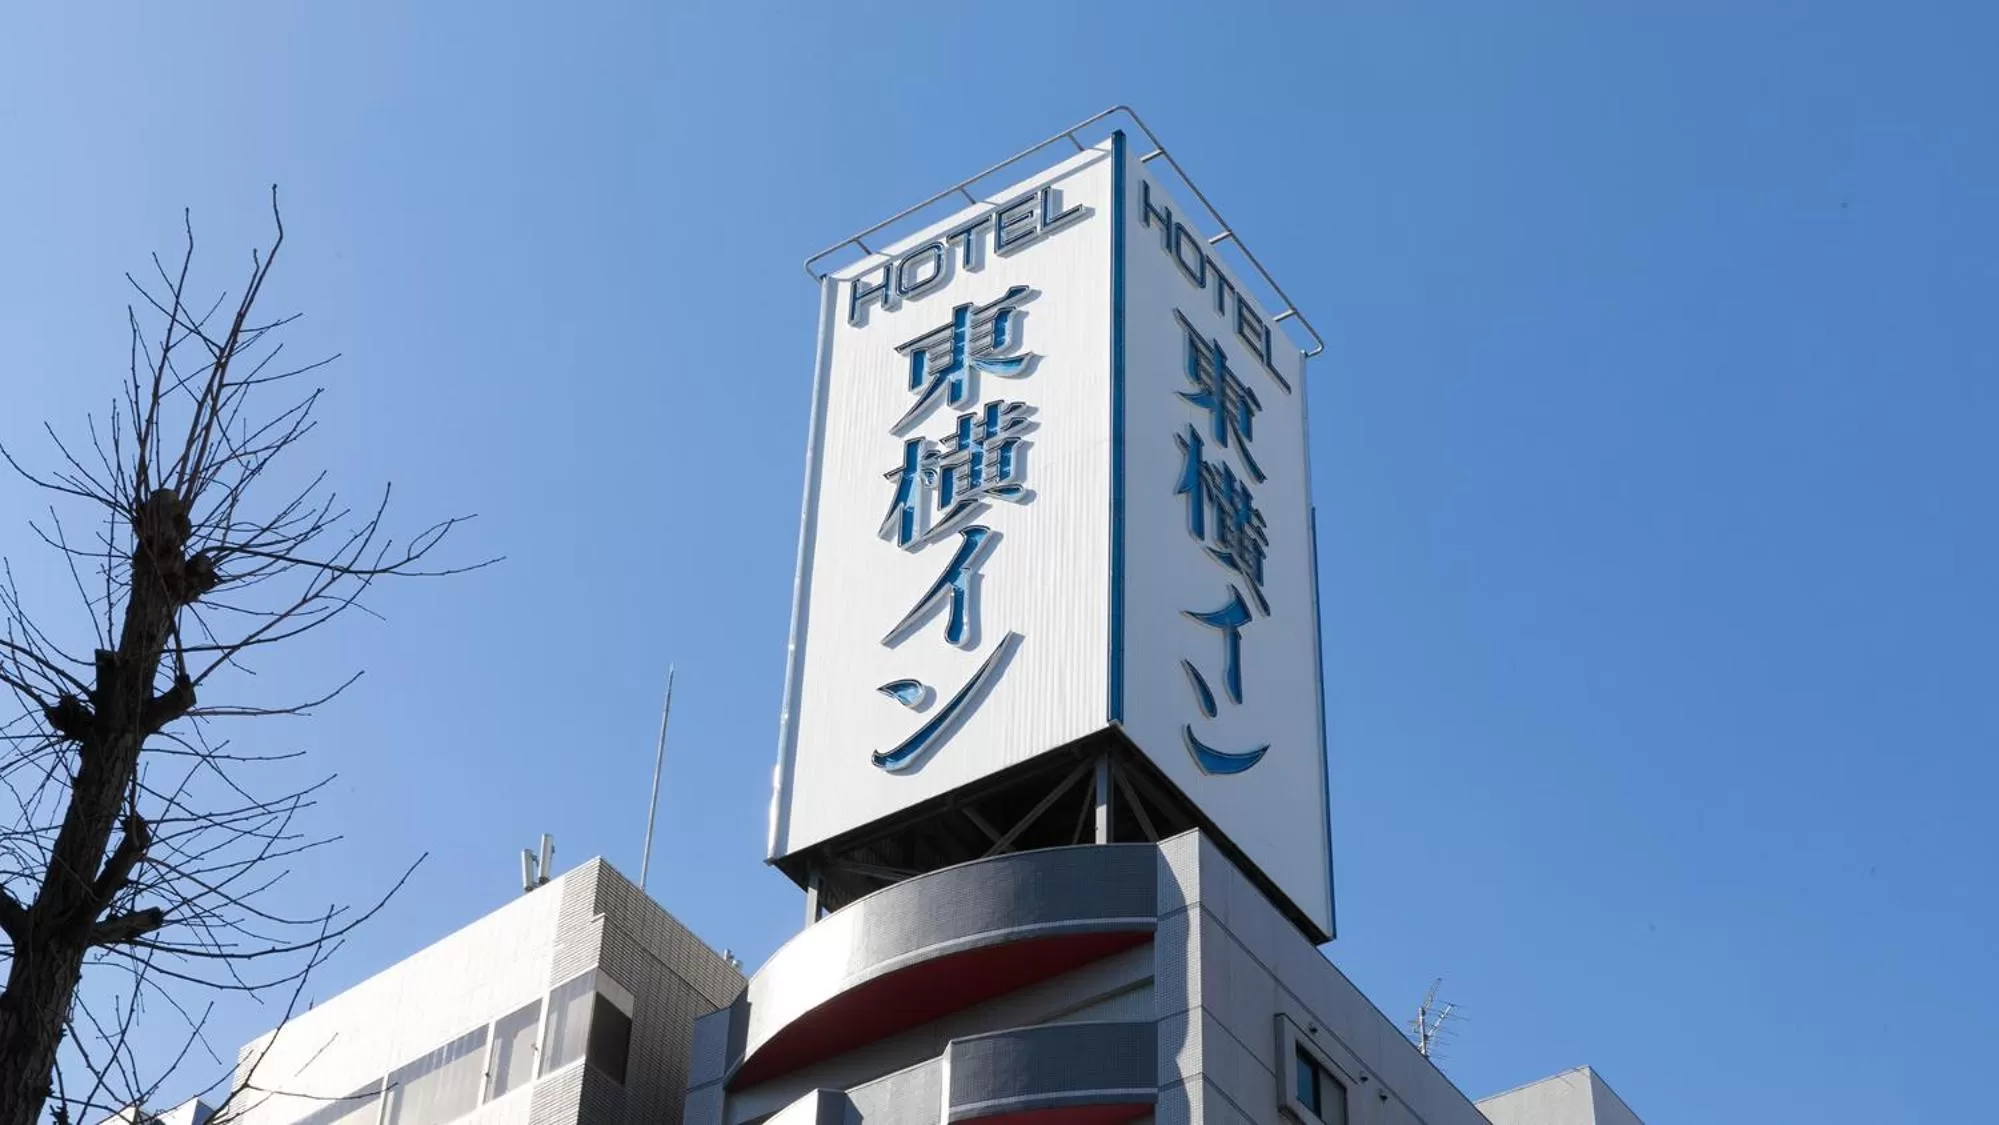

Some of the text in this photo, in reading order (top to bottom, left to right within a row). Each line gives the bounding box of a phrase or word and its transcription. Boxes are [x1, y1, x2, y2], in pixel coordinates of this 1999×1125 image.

[849, 186, 1084, 325] HOTEL
[1140, 180, 1292, 394] HOTEL
[871, 284, 1037, 775] 東横イン
[1173, 307, 1270, 775] 東横イン
